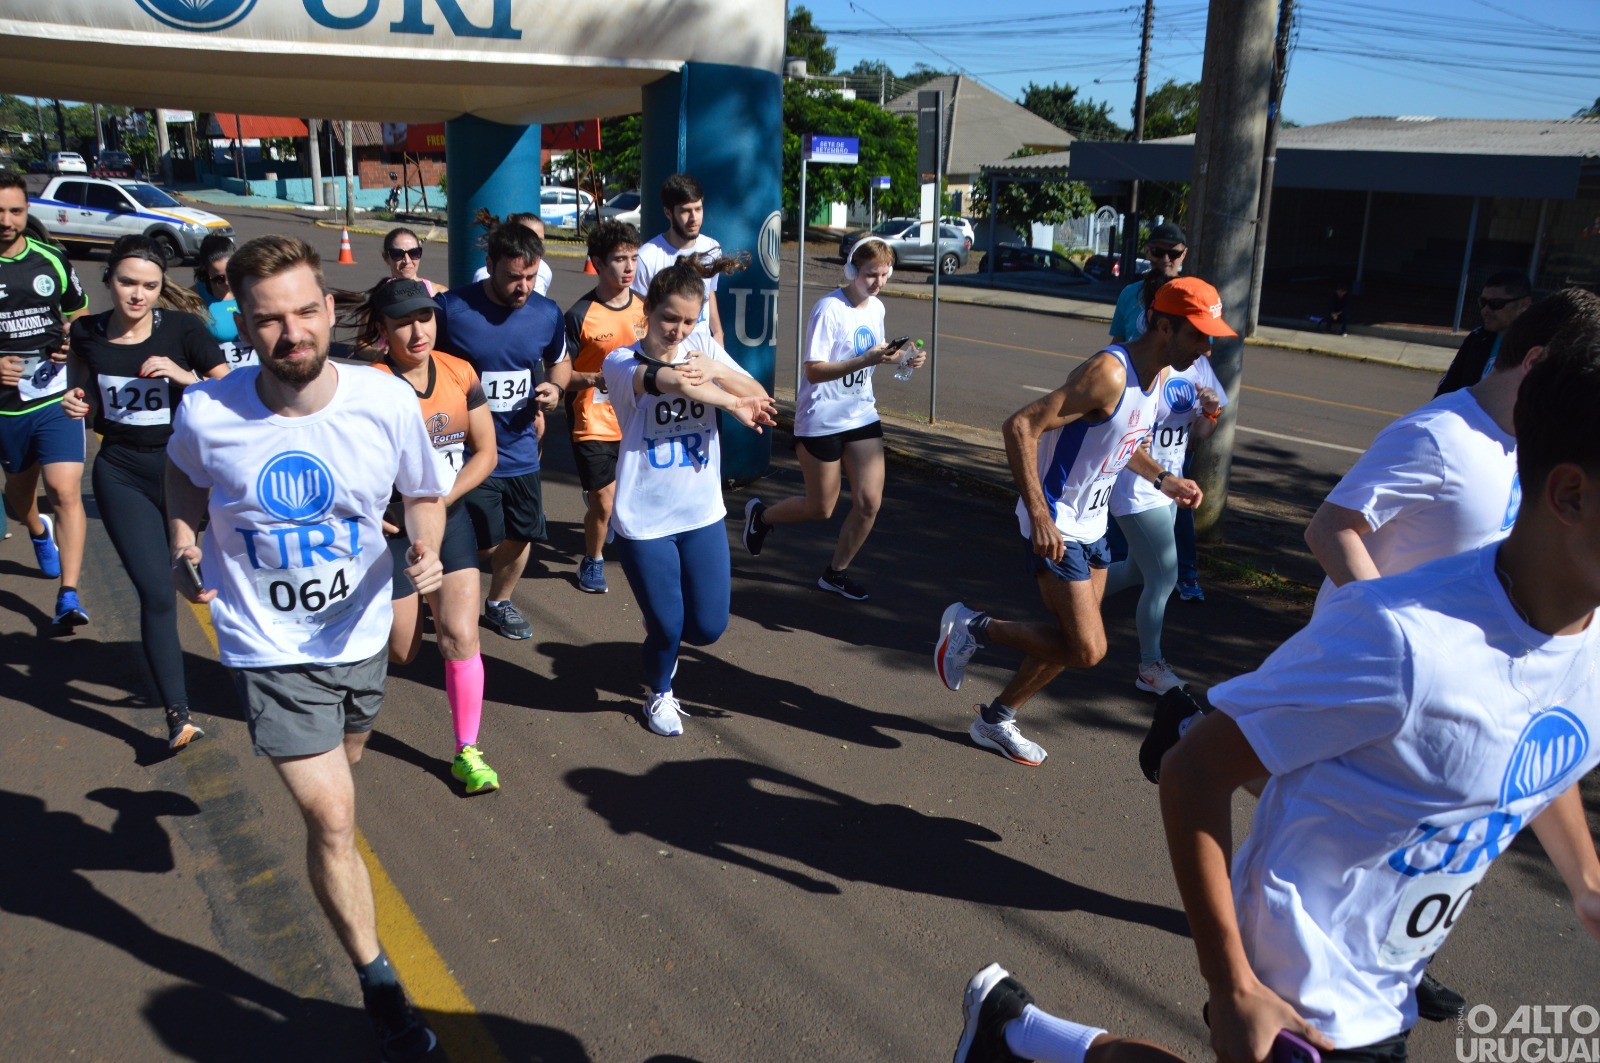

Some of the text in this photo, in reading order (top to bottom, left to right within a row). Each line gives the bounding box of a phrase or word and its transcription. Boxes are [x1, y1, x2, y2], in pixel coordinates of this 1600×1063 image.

[106, 386, 163, 411] 126
[487, 378, 527, 400] 134
[655, 398, 705, 426] 026
[433, 431, 465, 444] Forma
[235, 515, 366, 570] URI
[269, 568, 350, 613] 064
